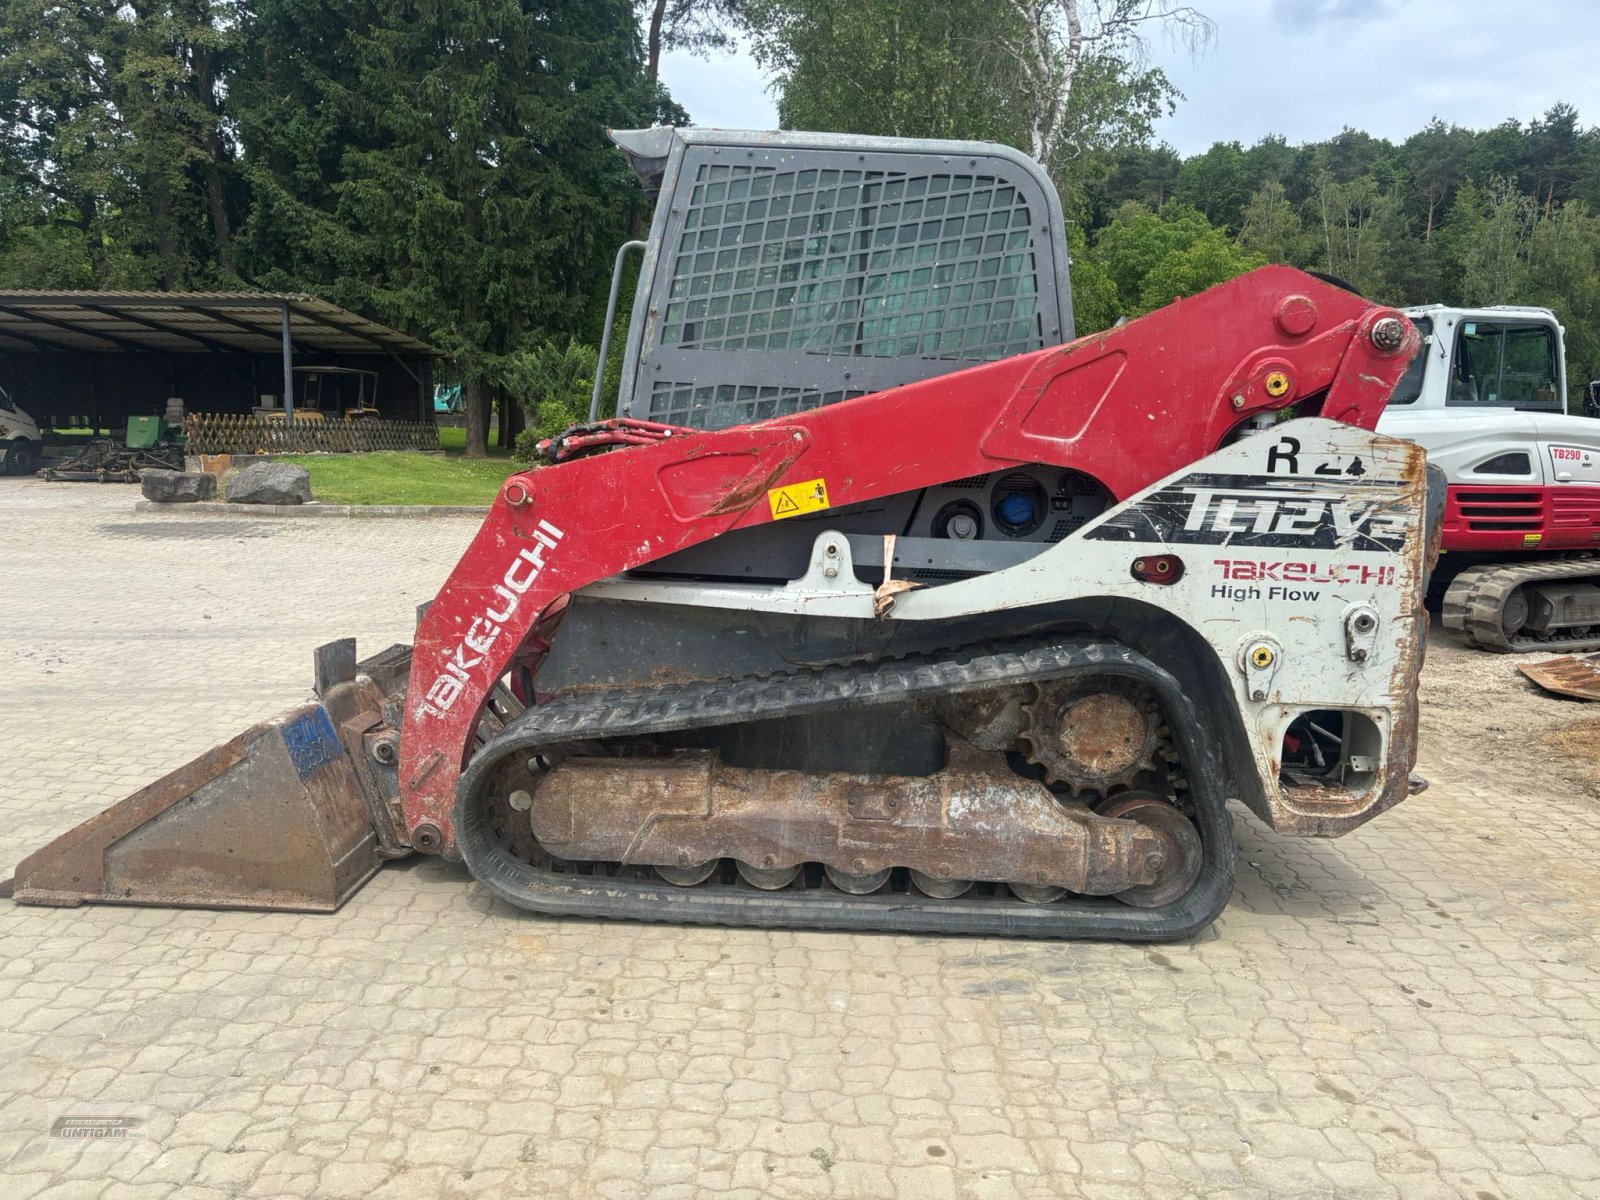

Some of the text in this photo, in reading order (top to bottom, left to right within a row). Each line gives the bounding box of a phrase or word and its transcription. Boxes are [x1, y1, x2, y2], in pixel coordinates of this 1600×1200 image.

[1553, 448, 1581, 461] TB290
[1211, 584, 1320, 602] High Flow
